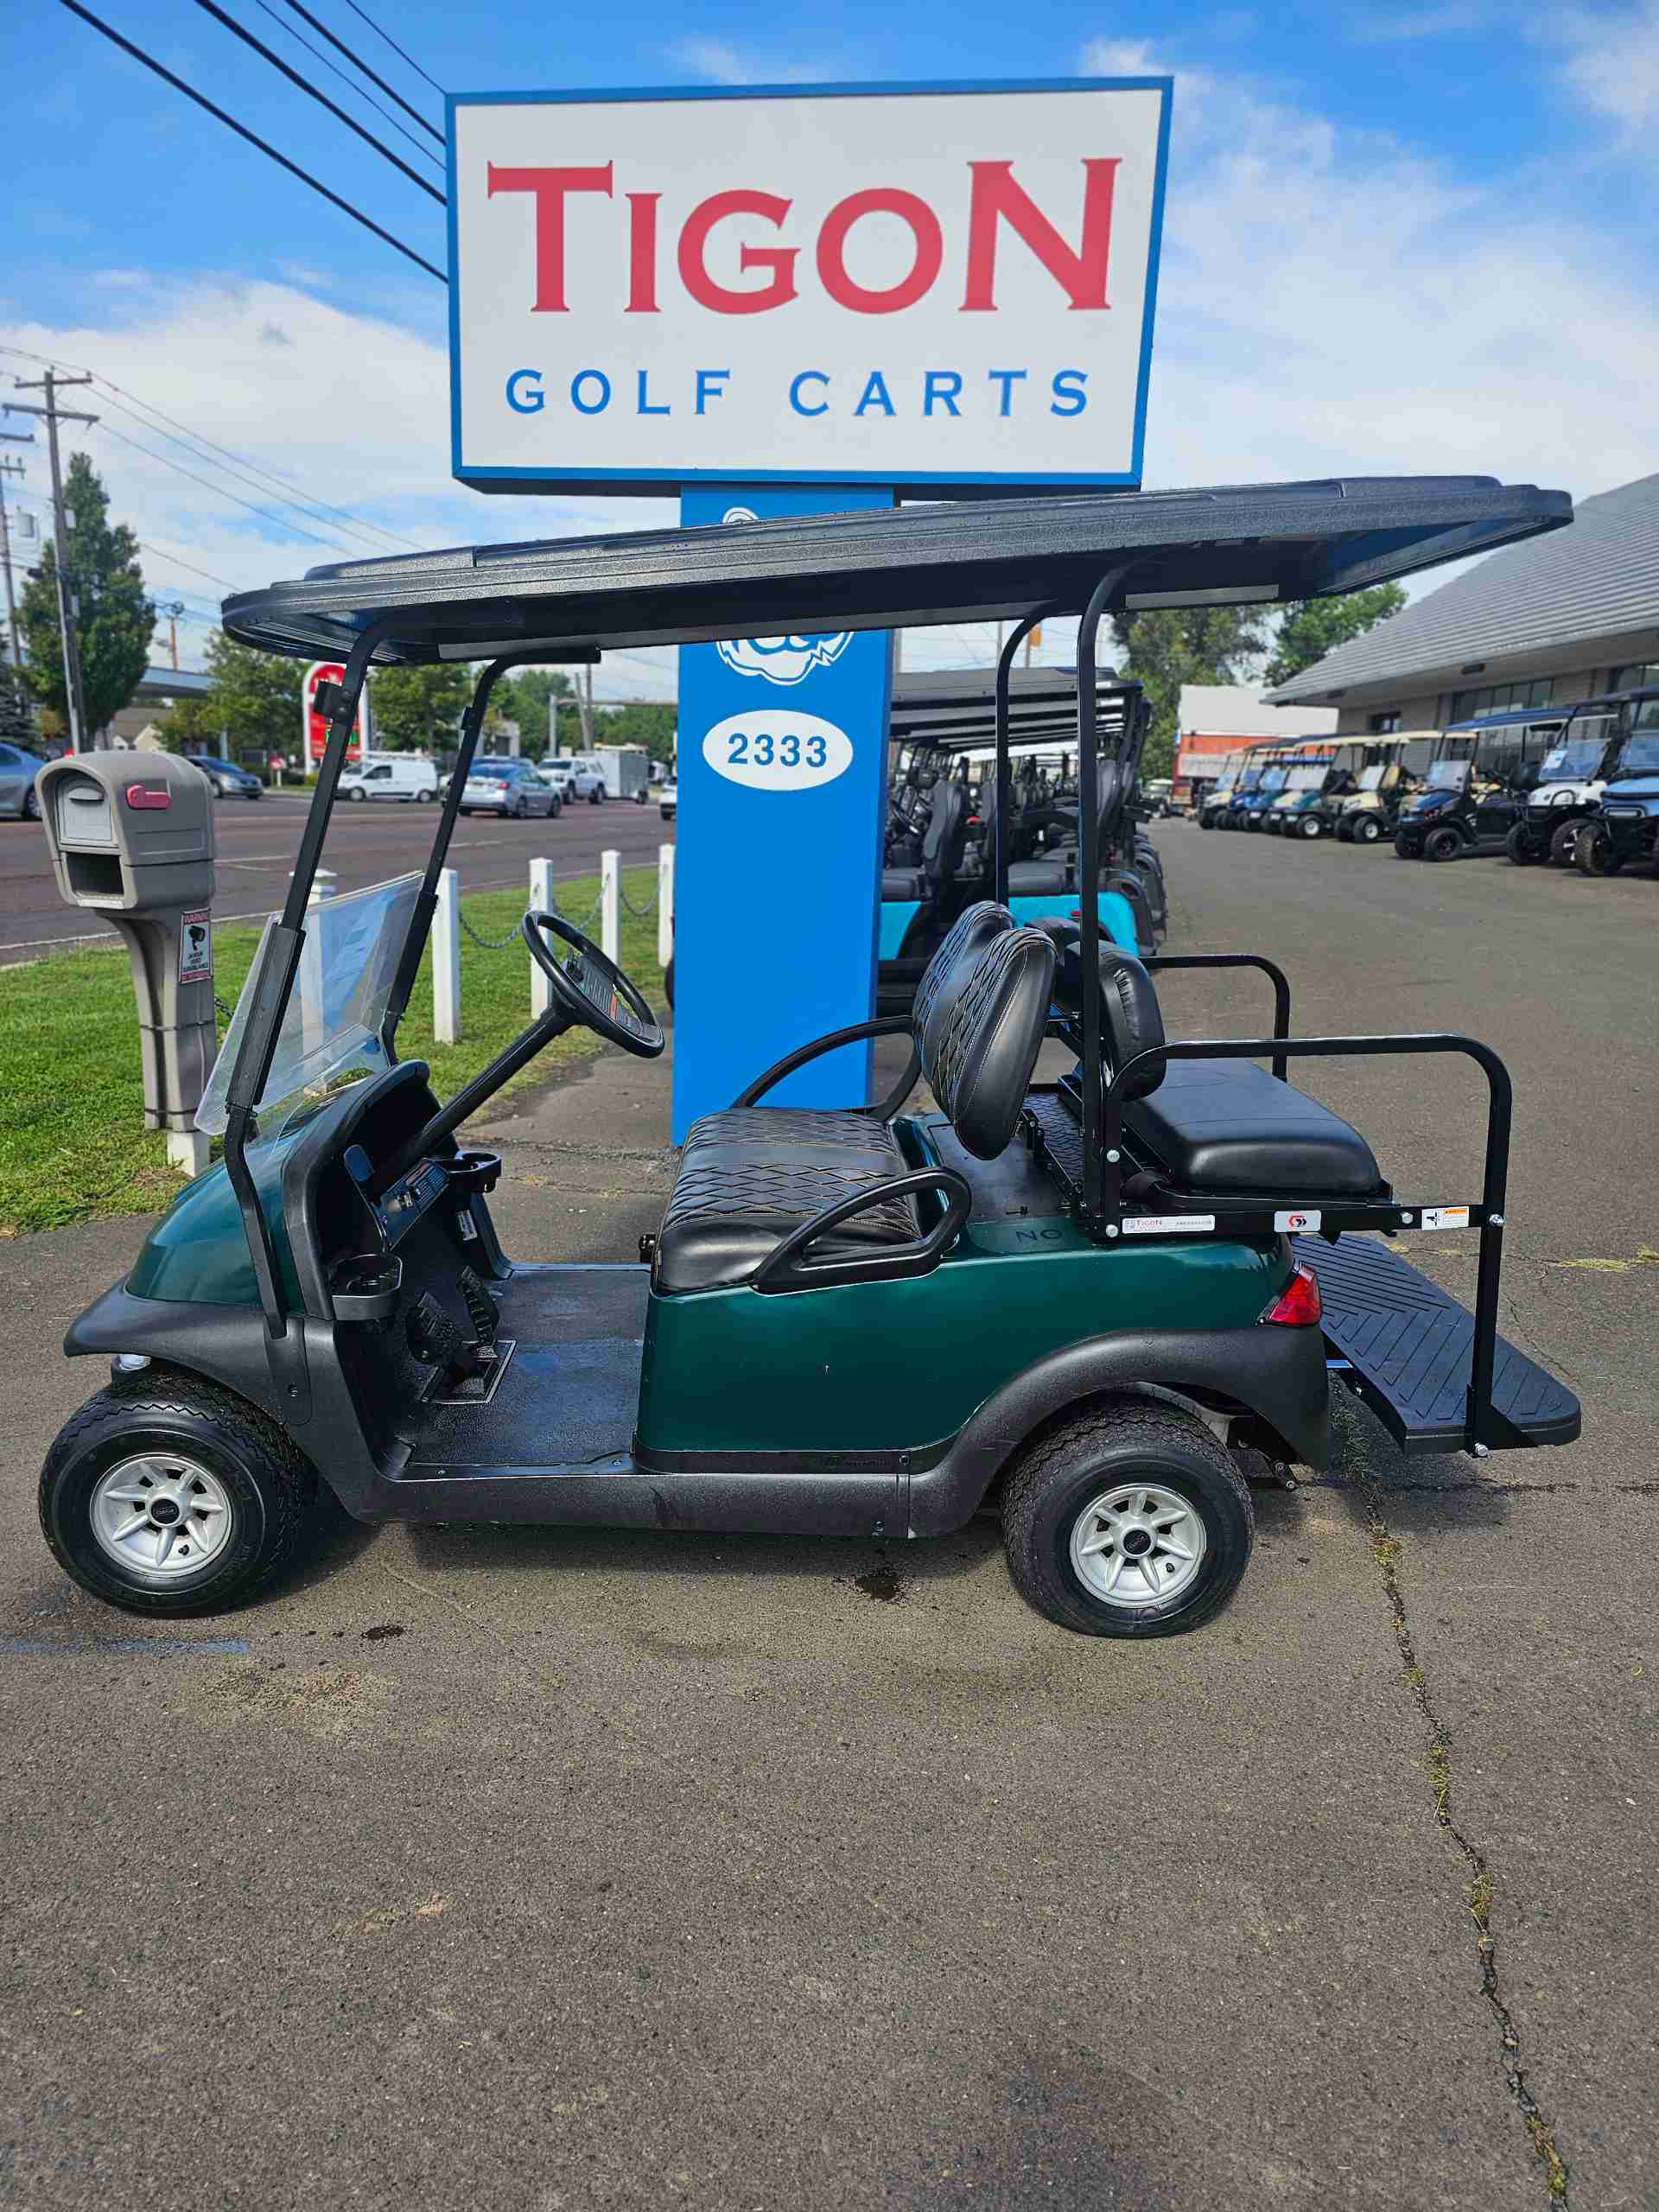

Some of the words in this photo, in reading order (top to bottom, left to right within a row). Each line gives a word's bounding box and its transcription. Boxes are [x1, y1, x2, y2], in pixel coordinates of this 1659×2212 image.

[487, 156, 1122, 315] TIGON
[505, 366, 733, 416] GOLF
[789, 366, 1090, 417] CARTS
[727, 732, 829, 768] 2333
